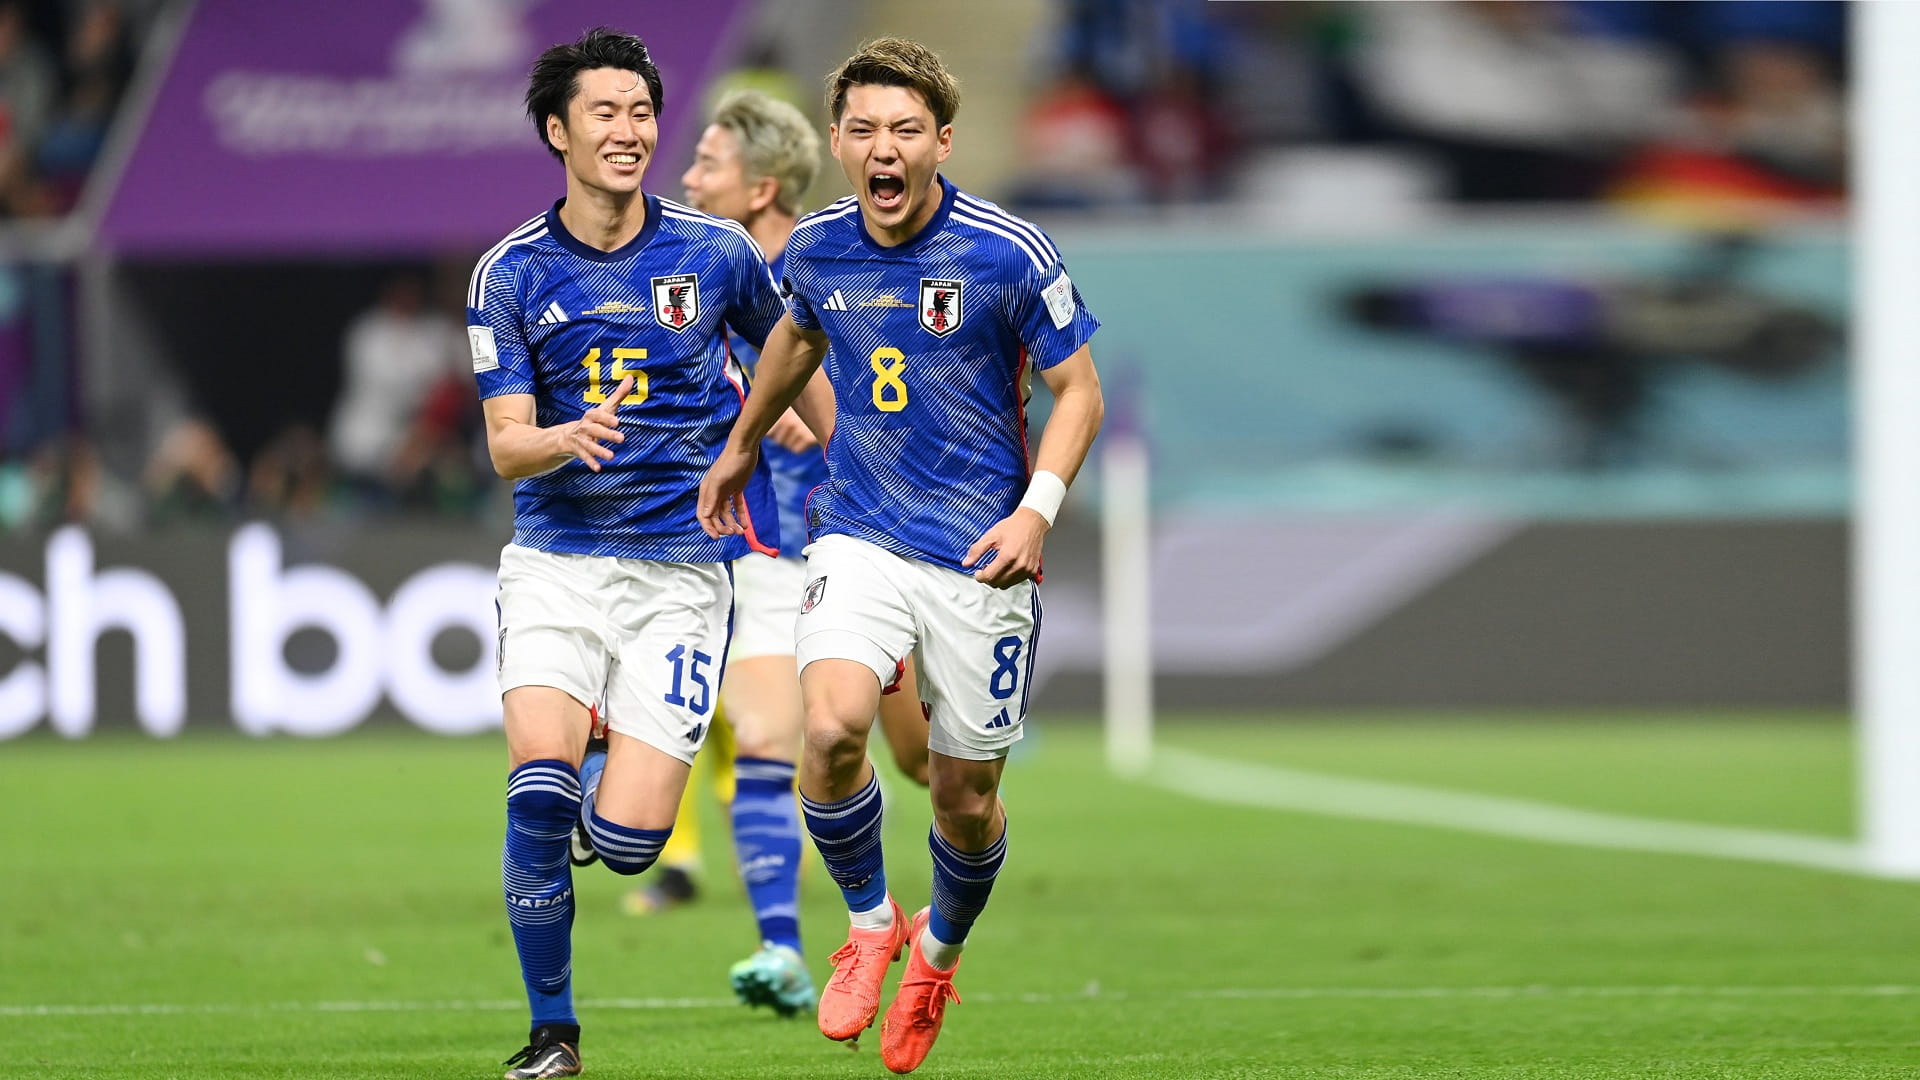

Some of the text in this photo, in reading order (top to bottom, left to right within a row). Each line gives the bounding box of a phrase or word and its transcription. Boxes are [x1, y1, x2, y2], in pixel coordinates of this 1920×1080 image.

[668, 313, 688, 322] JFA
[930, 318, 949, 327] JFA
[580, 347, 649, 405] 15
[870, 347, 909, 412] 8
[664, 643, 712, 716] 15
[989, 635, 1023, 700] 8
[507, 887, 572, 908] JAPAN
